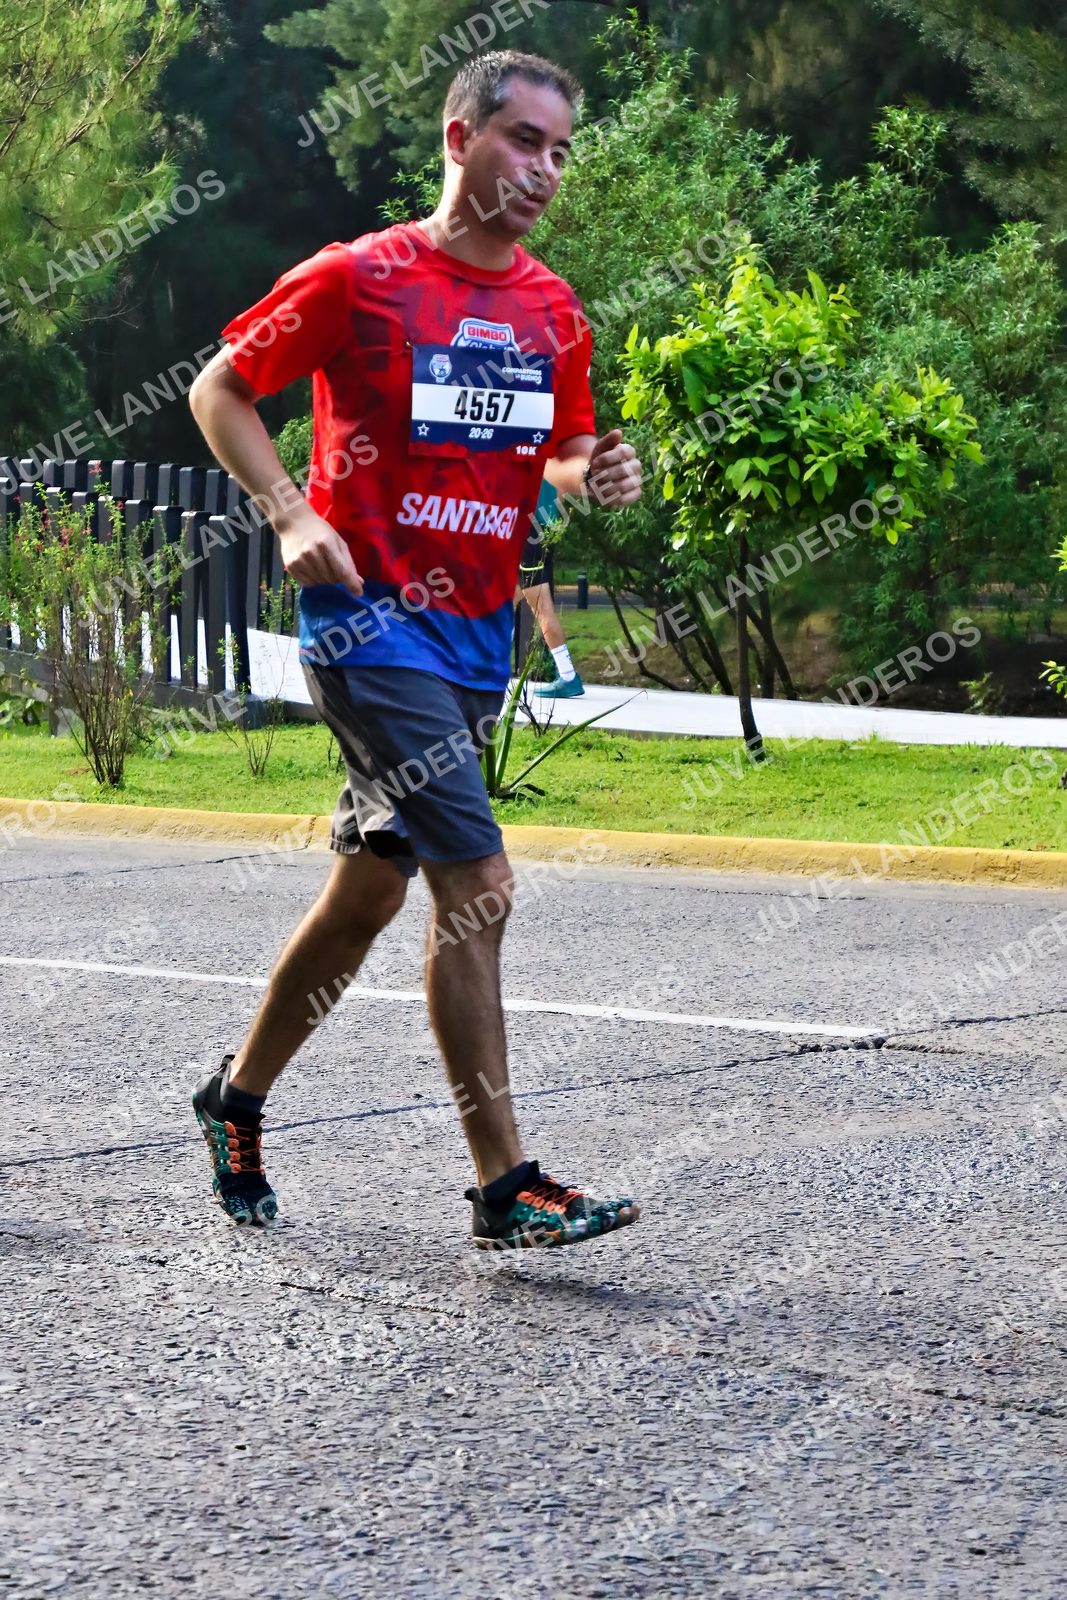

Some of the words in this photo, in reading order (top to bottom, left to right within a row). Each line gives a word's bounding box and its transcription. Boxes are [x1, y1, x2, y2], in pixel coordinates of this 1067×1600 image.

[467, 325, 507, 341] BIMBO
[454, 389, 515, 423] 4557
[515, 445, 537, 456] 10K
[396, 492, 519, 540] SANTIAGO
